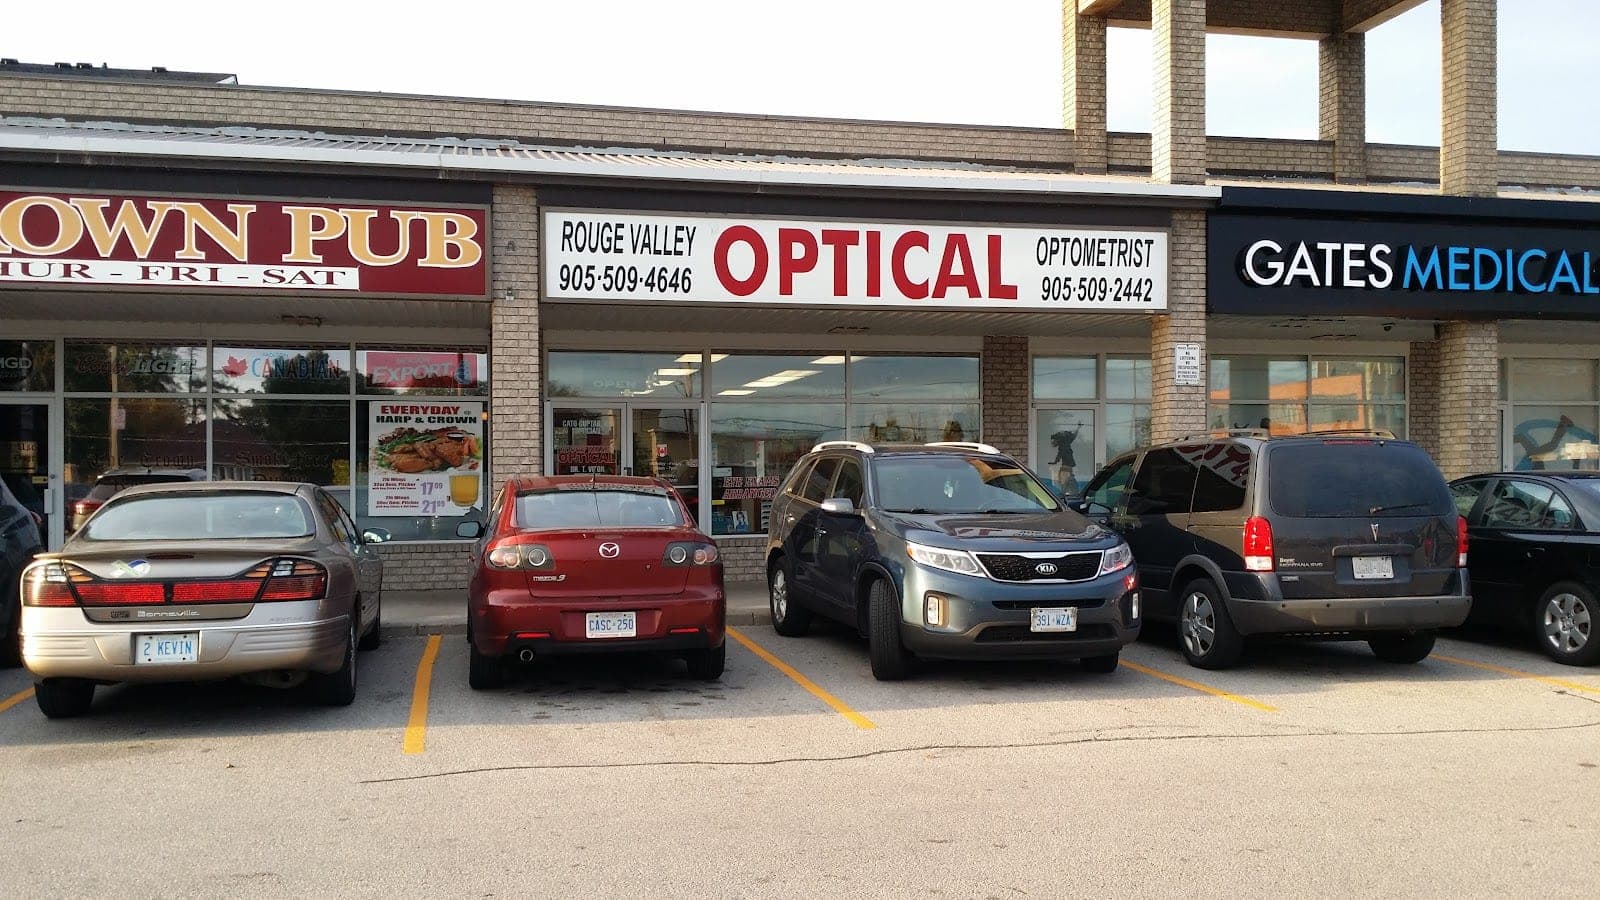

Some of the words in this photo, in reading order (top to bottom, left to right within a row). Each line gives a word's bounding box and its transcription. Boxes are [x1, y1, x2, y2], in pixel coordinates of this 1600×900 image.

[0, 195, 257, 263] OWN
[282, 206, 482, 268] PUB
[561, 220, 625, 254] ROUGE
[630, 223, 697, 256] VALLEY
[713, 224, 1018, 300] OPTICAL
[1036, 236, 1154, 268] OPTOMETRIST
[136, 265, 222, 282] FRI
[262, 269, 346, 286] SAT
[1244, 239, 1394, 289] GATES
[1402, 243, 1600, 294] MEDICAL
[251, 357, 341, 378] CANADIAN
[371, 362, 450, 385] EXPORT
[375, 415, 412, 424] HARP
[414, 416, 425, 424] &
[427, 416, 477, 424] CROWN
[380, 405, 461, 415] EVERYDAY
[559, 452, 616, 464] OPTICAL
[1039, 564, 1056, 573] KIA
[143, 641, 152, 656] 2
[157, 640, 193, 656] KEVIN
